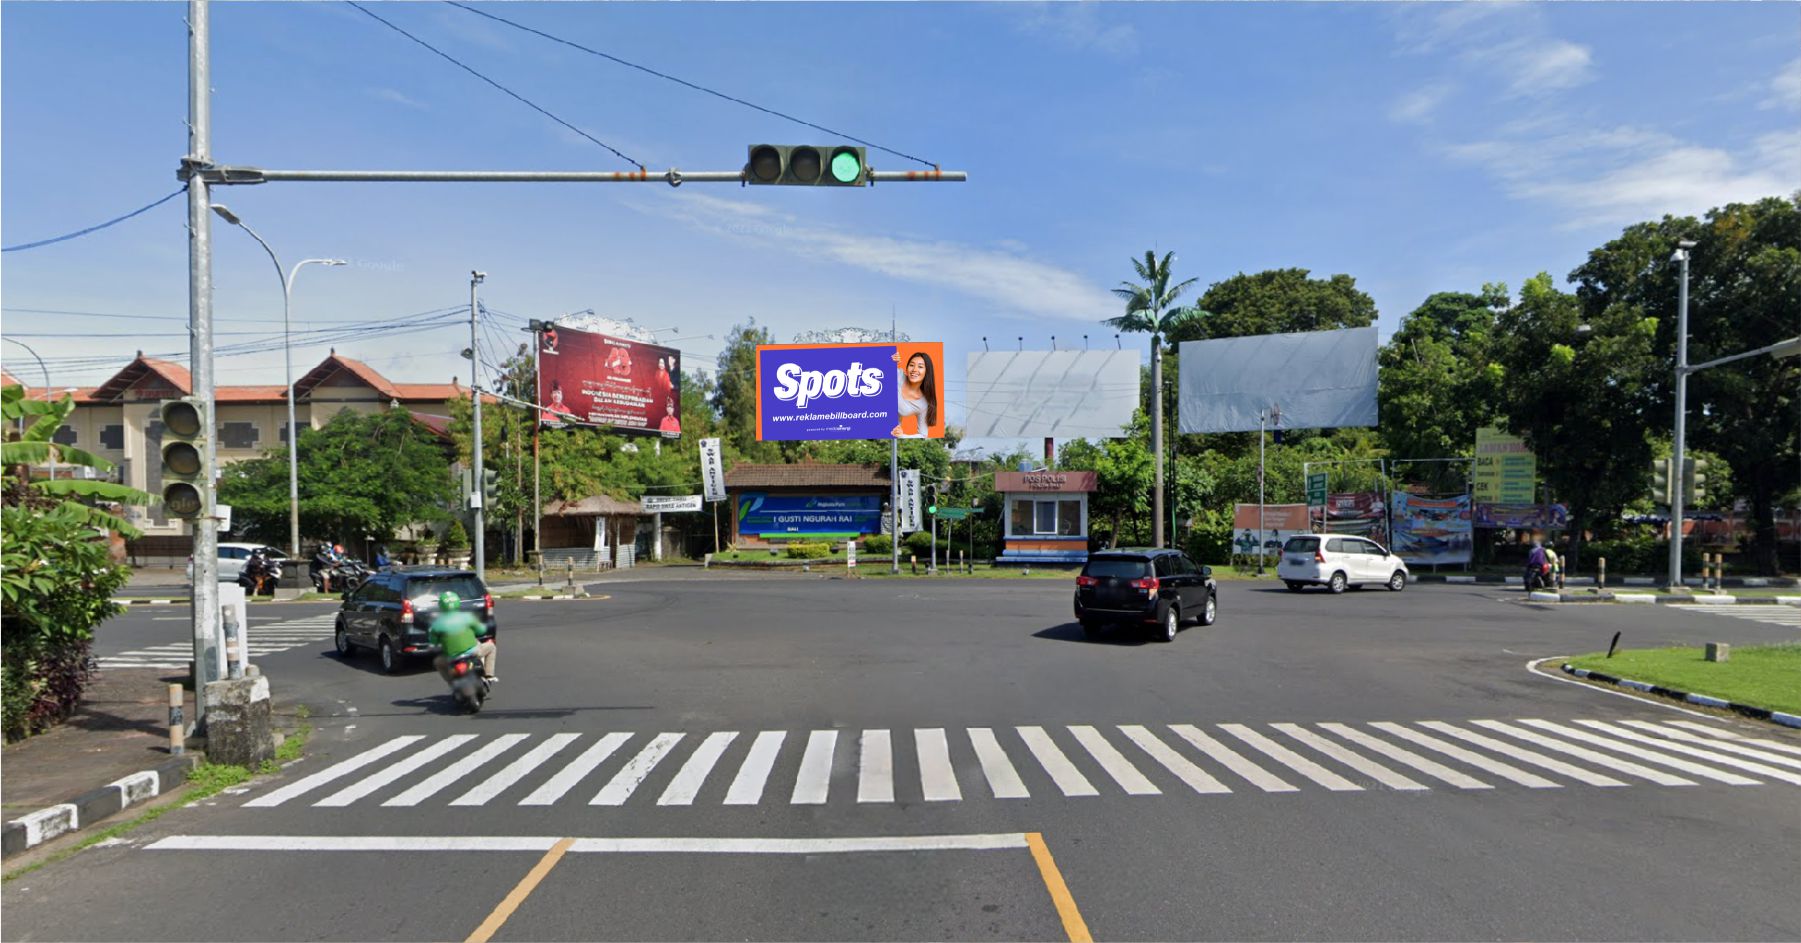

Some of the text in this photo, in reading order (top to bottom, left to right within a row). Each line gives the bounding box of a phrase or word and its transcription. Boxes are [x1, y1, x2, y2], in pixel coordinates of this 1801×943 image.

[773, 361, 884, 409] Spots
[772, 410, 888, 423] www.reklamebillboard.com
[778, 515, 802, 523] GUSTI
[802, 515, 837, 523] NGURAH
[838, 515, 853, 523] RAI
